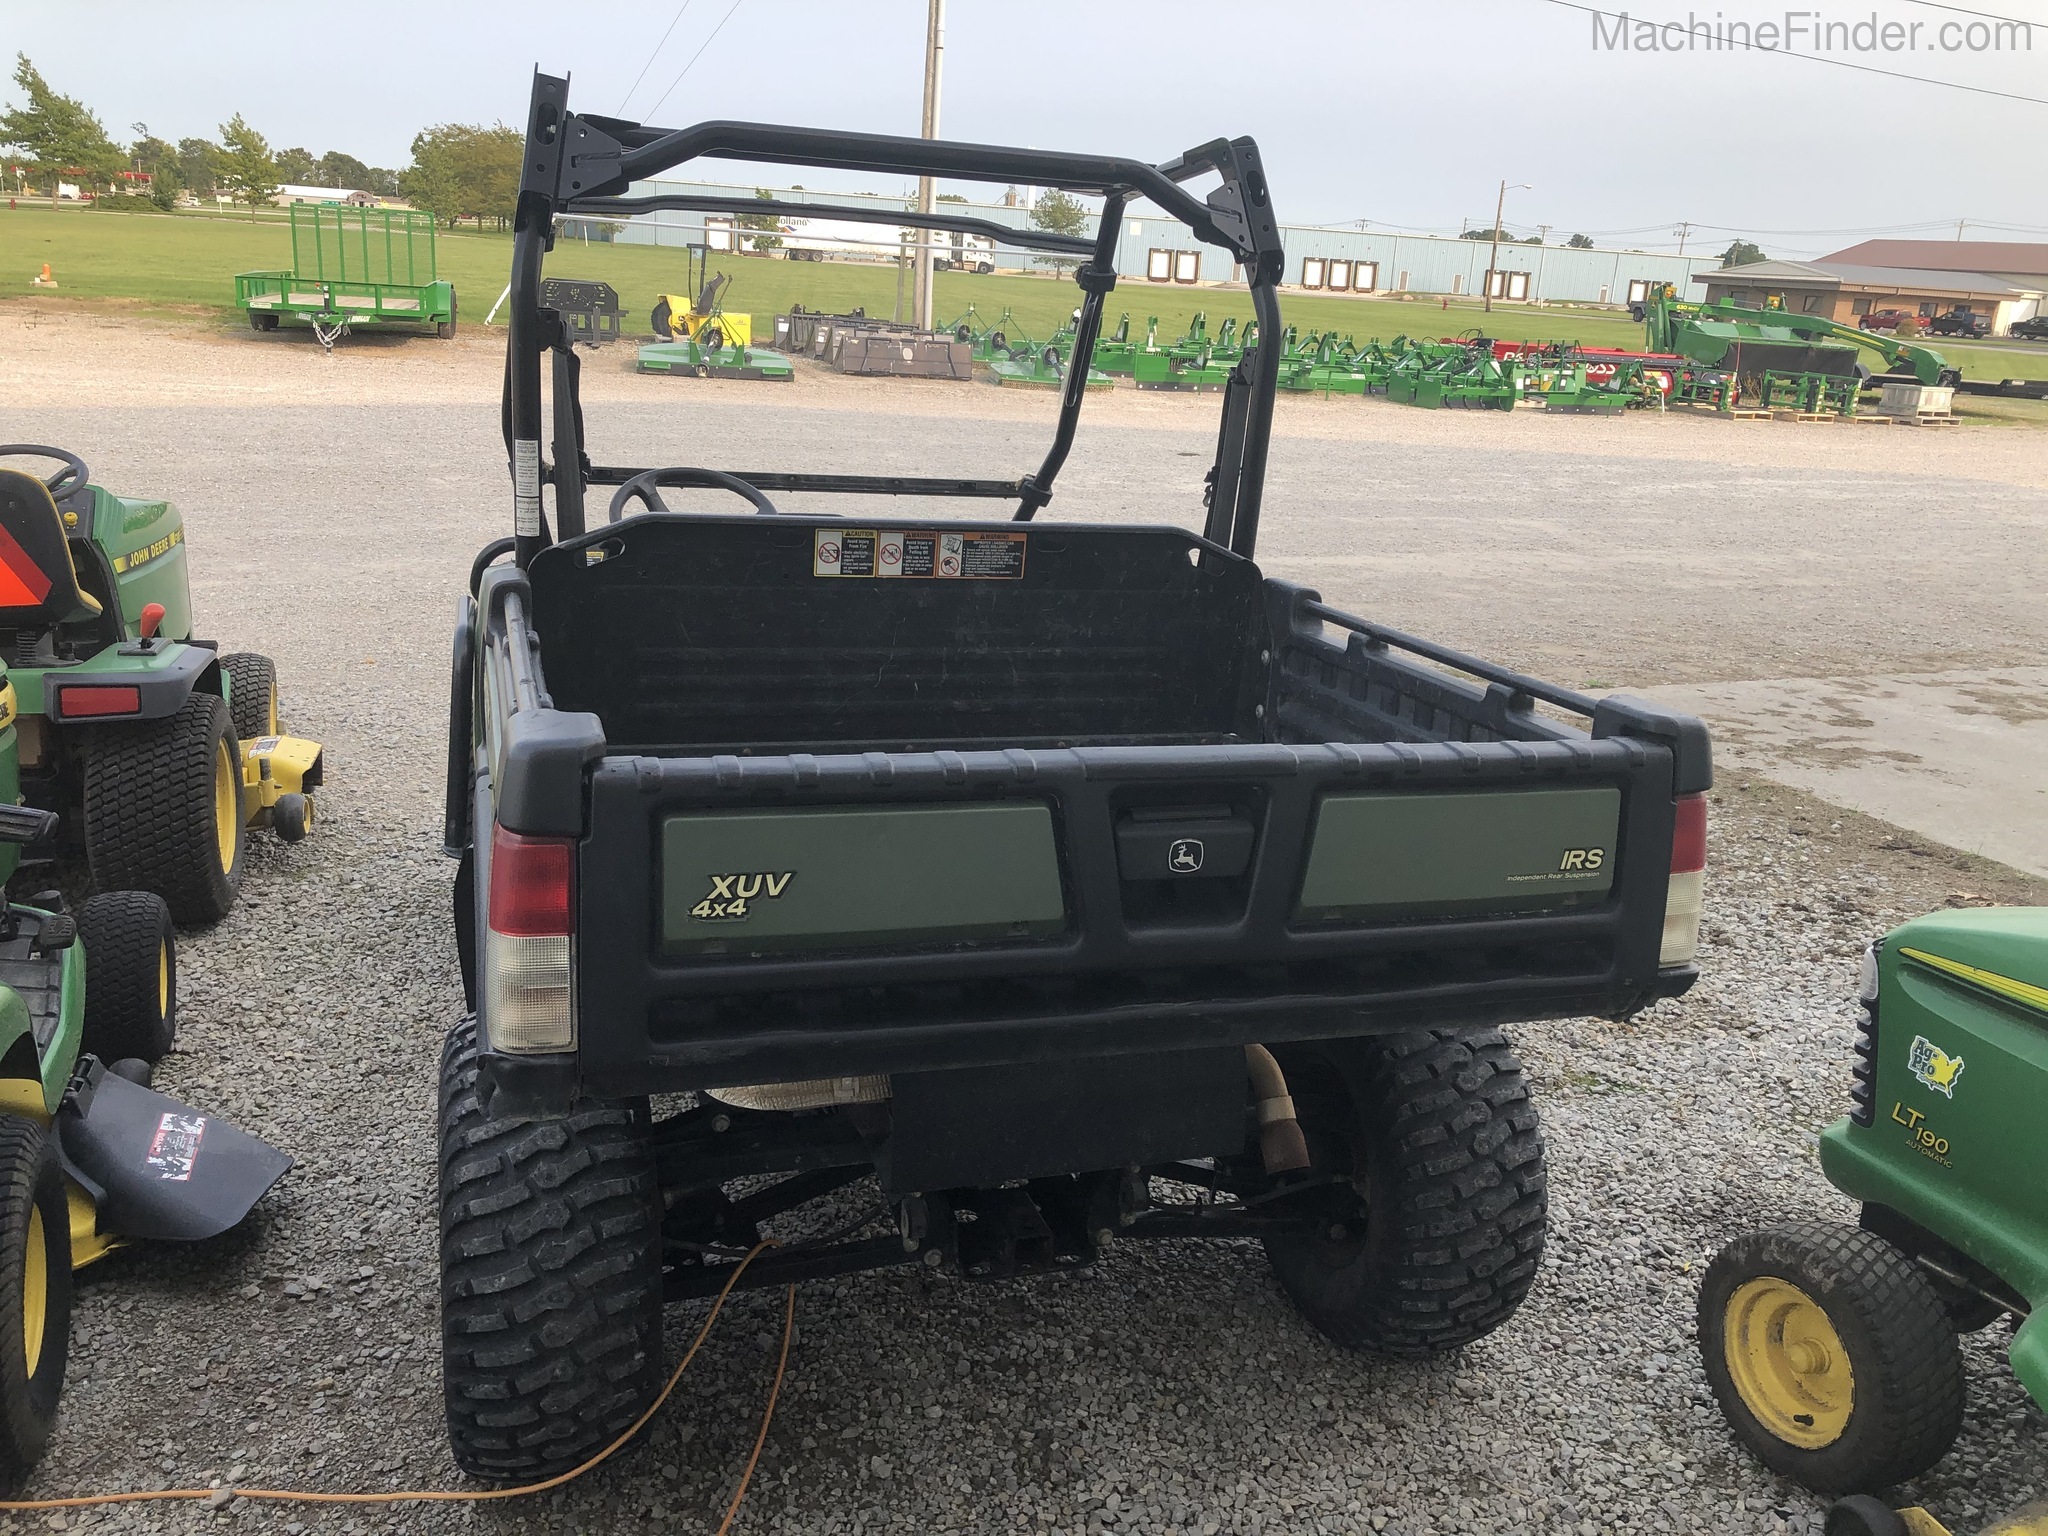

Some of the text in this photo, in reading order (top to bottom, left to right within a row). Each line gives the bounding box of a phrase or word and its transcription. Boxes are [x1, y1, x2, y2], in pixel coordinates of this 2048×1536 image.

[776, 216, 807, 226] olland
[130, 537, 169, 568] JOHN DEERE
[1559, 848, 1604, 871] IRS
[706, 872, 793, 900] XUV
[1507, 874, 1547, 882] Independent
[1564, 871, 1600, 880] Suspension
[691, 897, 747, 918] 4x4
[1911, 1053, 1936, 1076] Pro
[1904, 1139, 1954, 1170] AUTOMATIC
